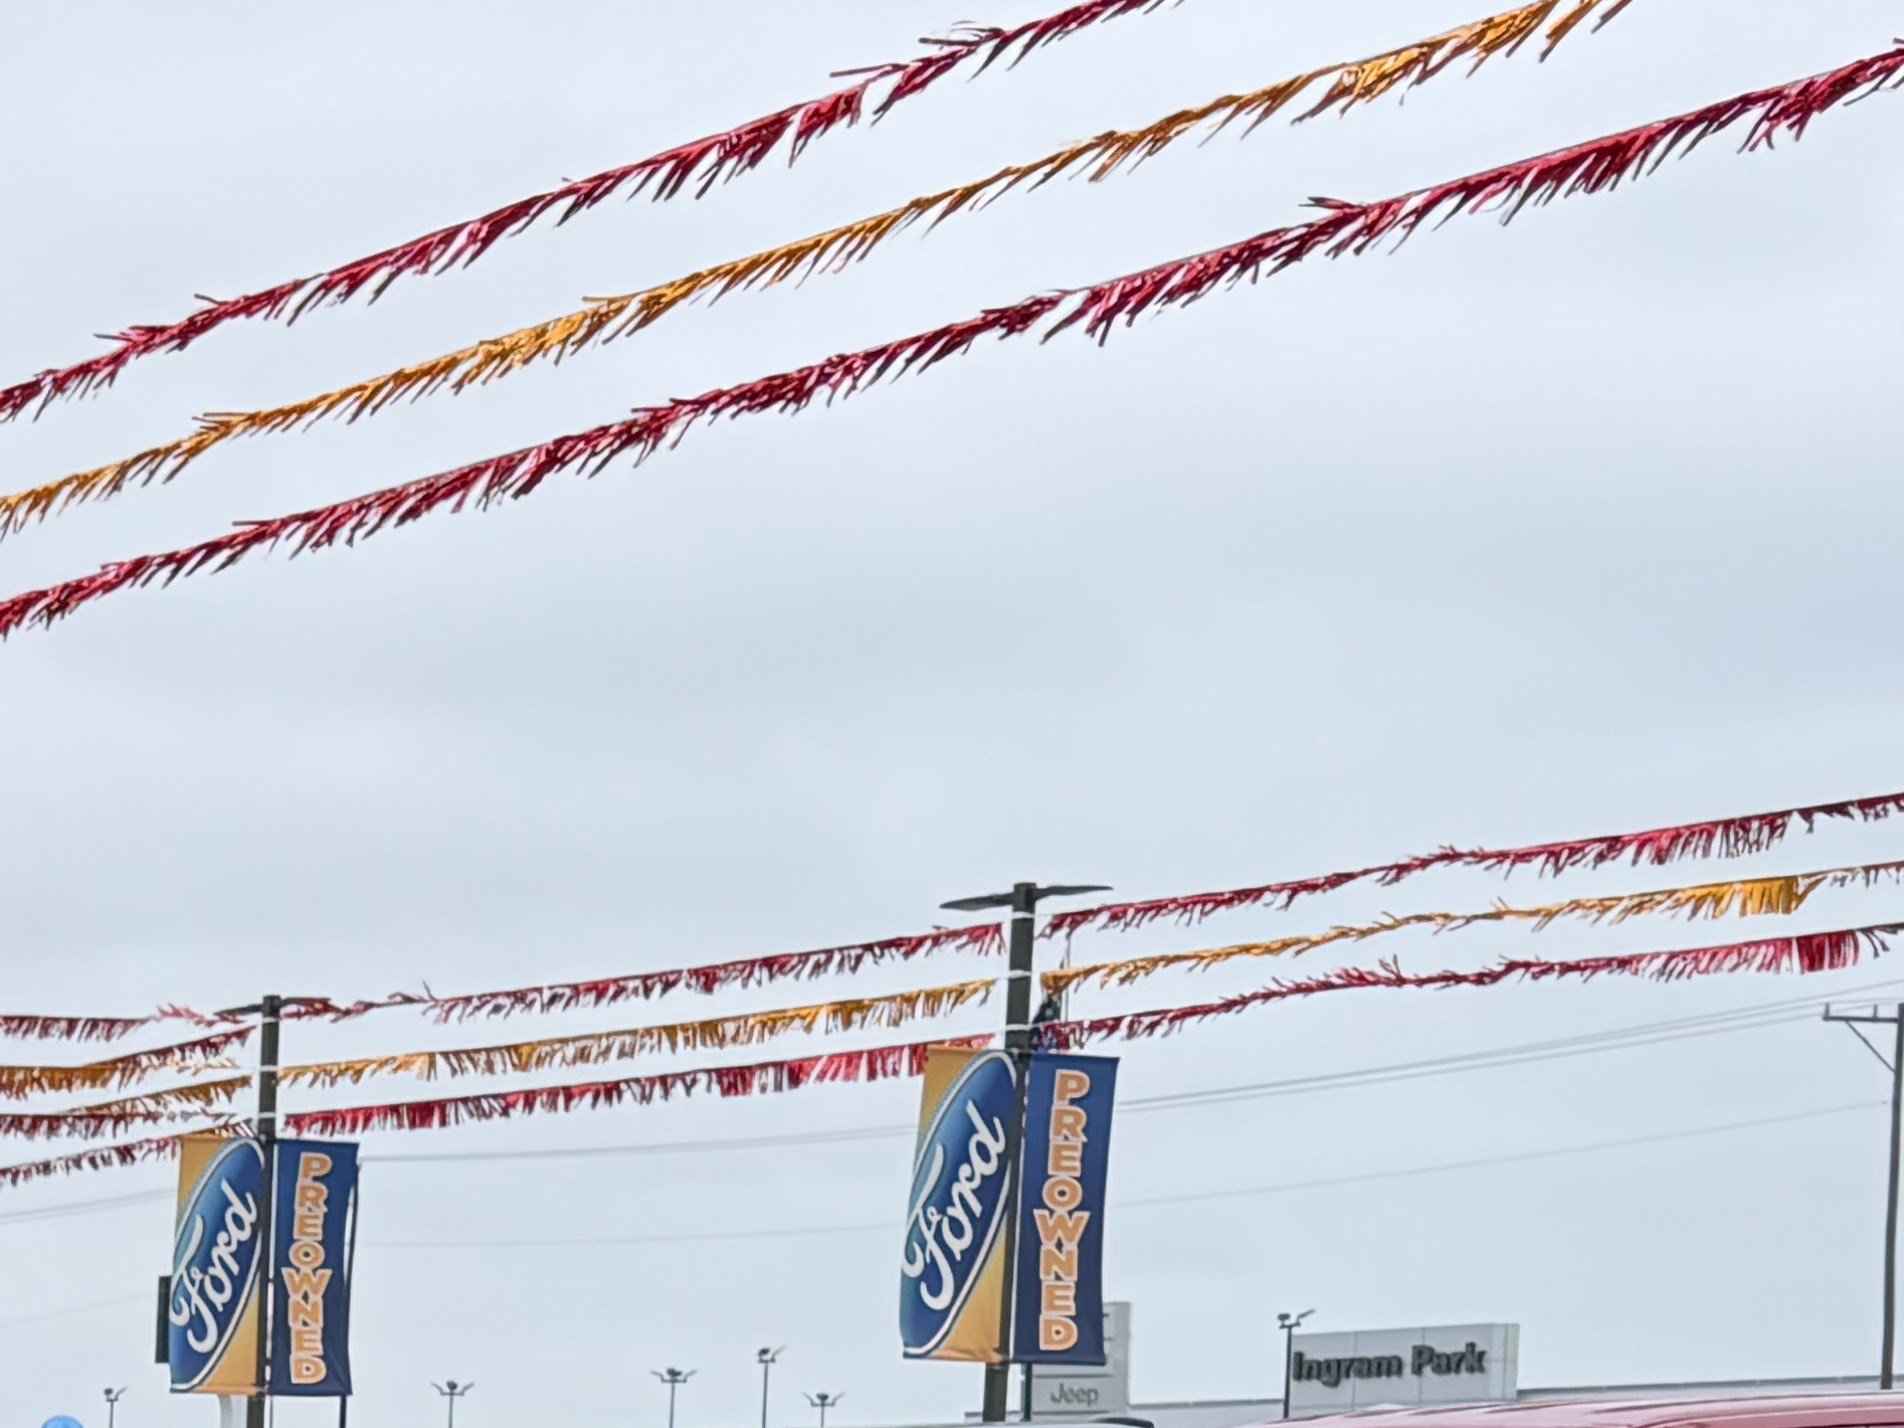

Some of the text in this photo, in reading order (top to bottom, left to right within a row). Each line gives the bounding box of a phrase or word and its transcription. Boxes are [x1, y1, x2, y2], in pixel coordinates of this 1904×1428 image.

[169, 1178, 258, 1354] Ford
[281, 1152, 333, 1385] PREOWNED
[901, 1099, 1006, 1311] Ford
[1033, 1069, 1090, 1351] PREOWNED
[1050, 1382, 1099, 1406] Jeep
[1293, 1341, 1487, 1388] Ingram Park
